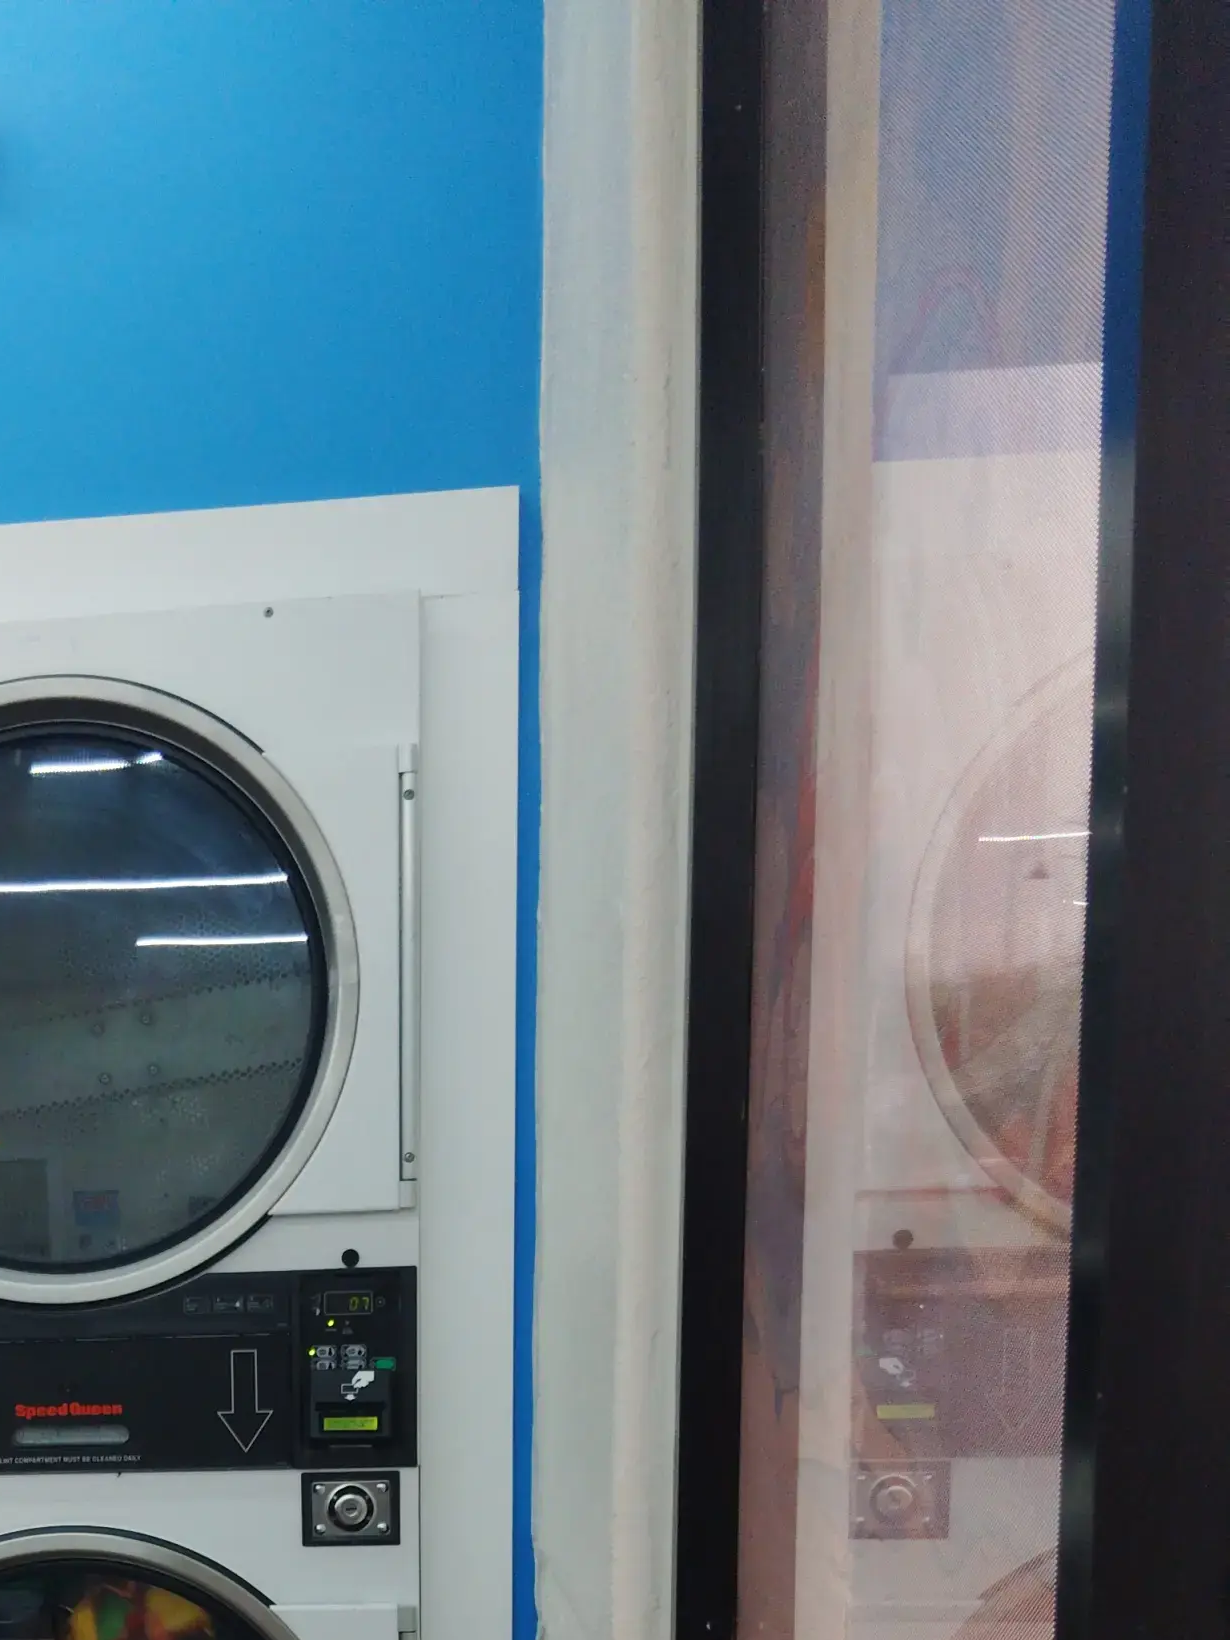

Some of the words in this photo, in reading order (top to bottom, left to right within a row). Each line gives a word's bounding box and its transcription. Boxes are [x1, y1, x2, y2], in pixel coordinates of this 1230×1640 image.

[349, 1297, 369, 1311] 07
[15, 1402, 68, 1420] Speed
[69, 1401, 122, 1416] Queen
